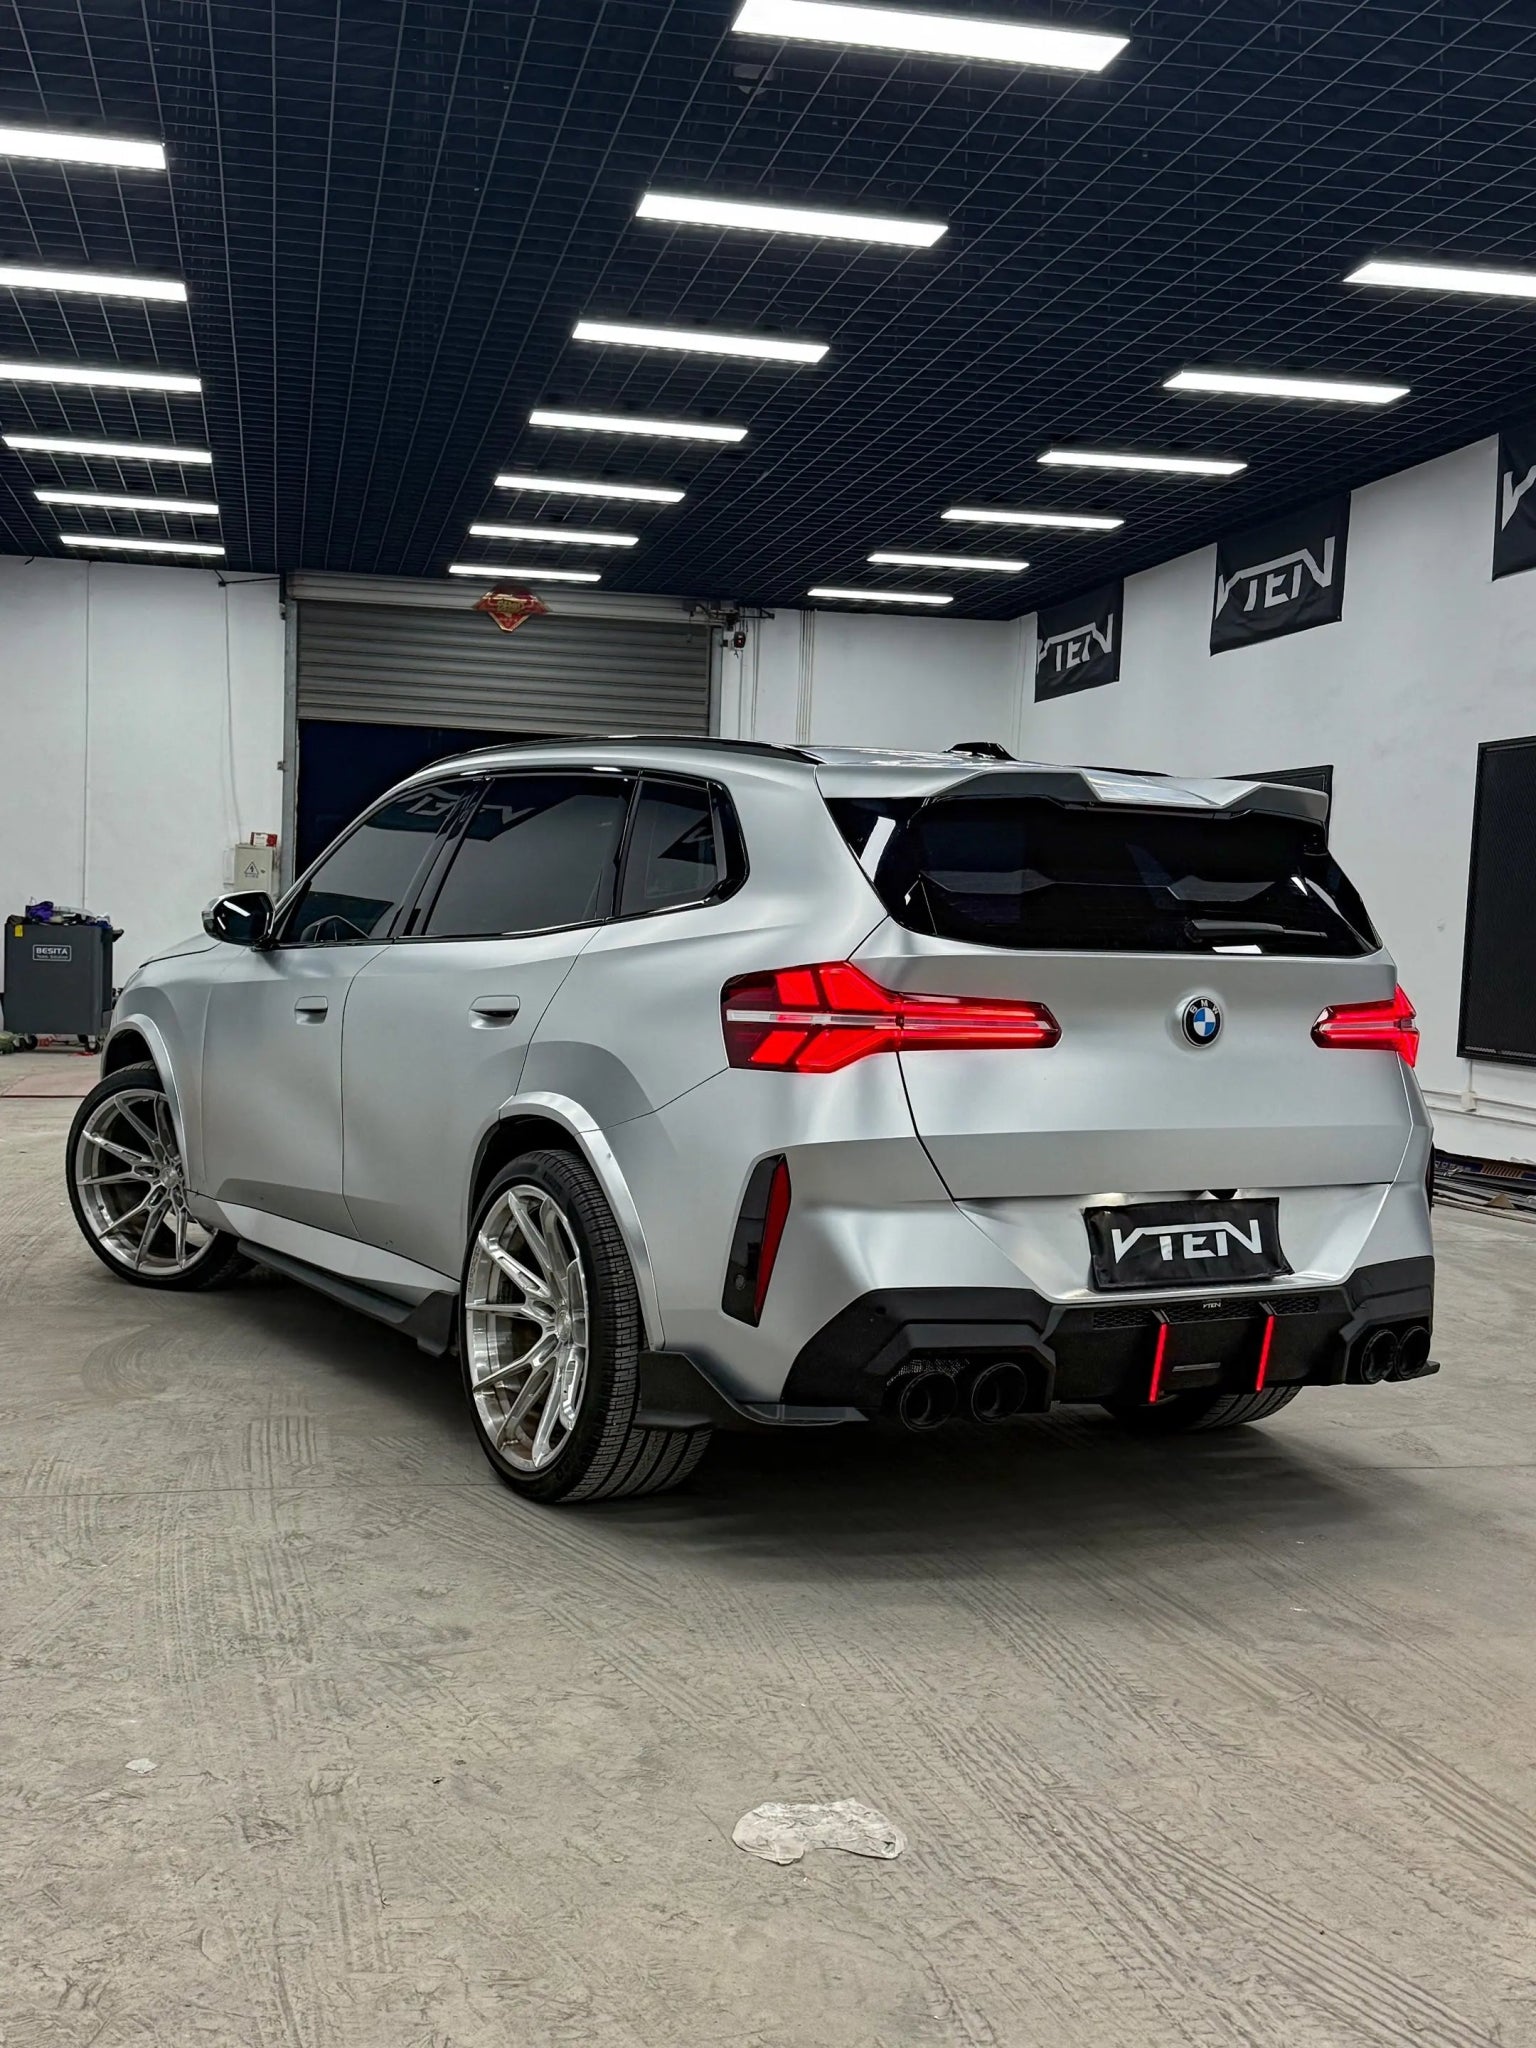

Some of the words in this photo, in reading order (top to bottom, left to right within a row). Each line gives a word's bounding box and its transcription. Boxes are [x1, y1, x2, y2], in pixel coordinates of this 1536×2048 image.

[1214, 536, 1336, 620] VTEN
[36, 947, 68, 955] BESITA
[1189, 1000, 1219, 1015] BMW
[1111, 1219, 1263, 1265] VTEN
